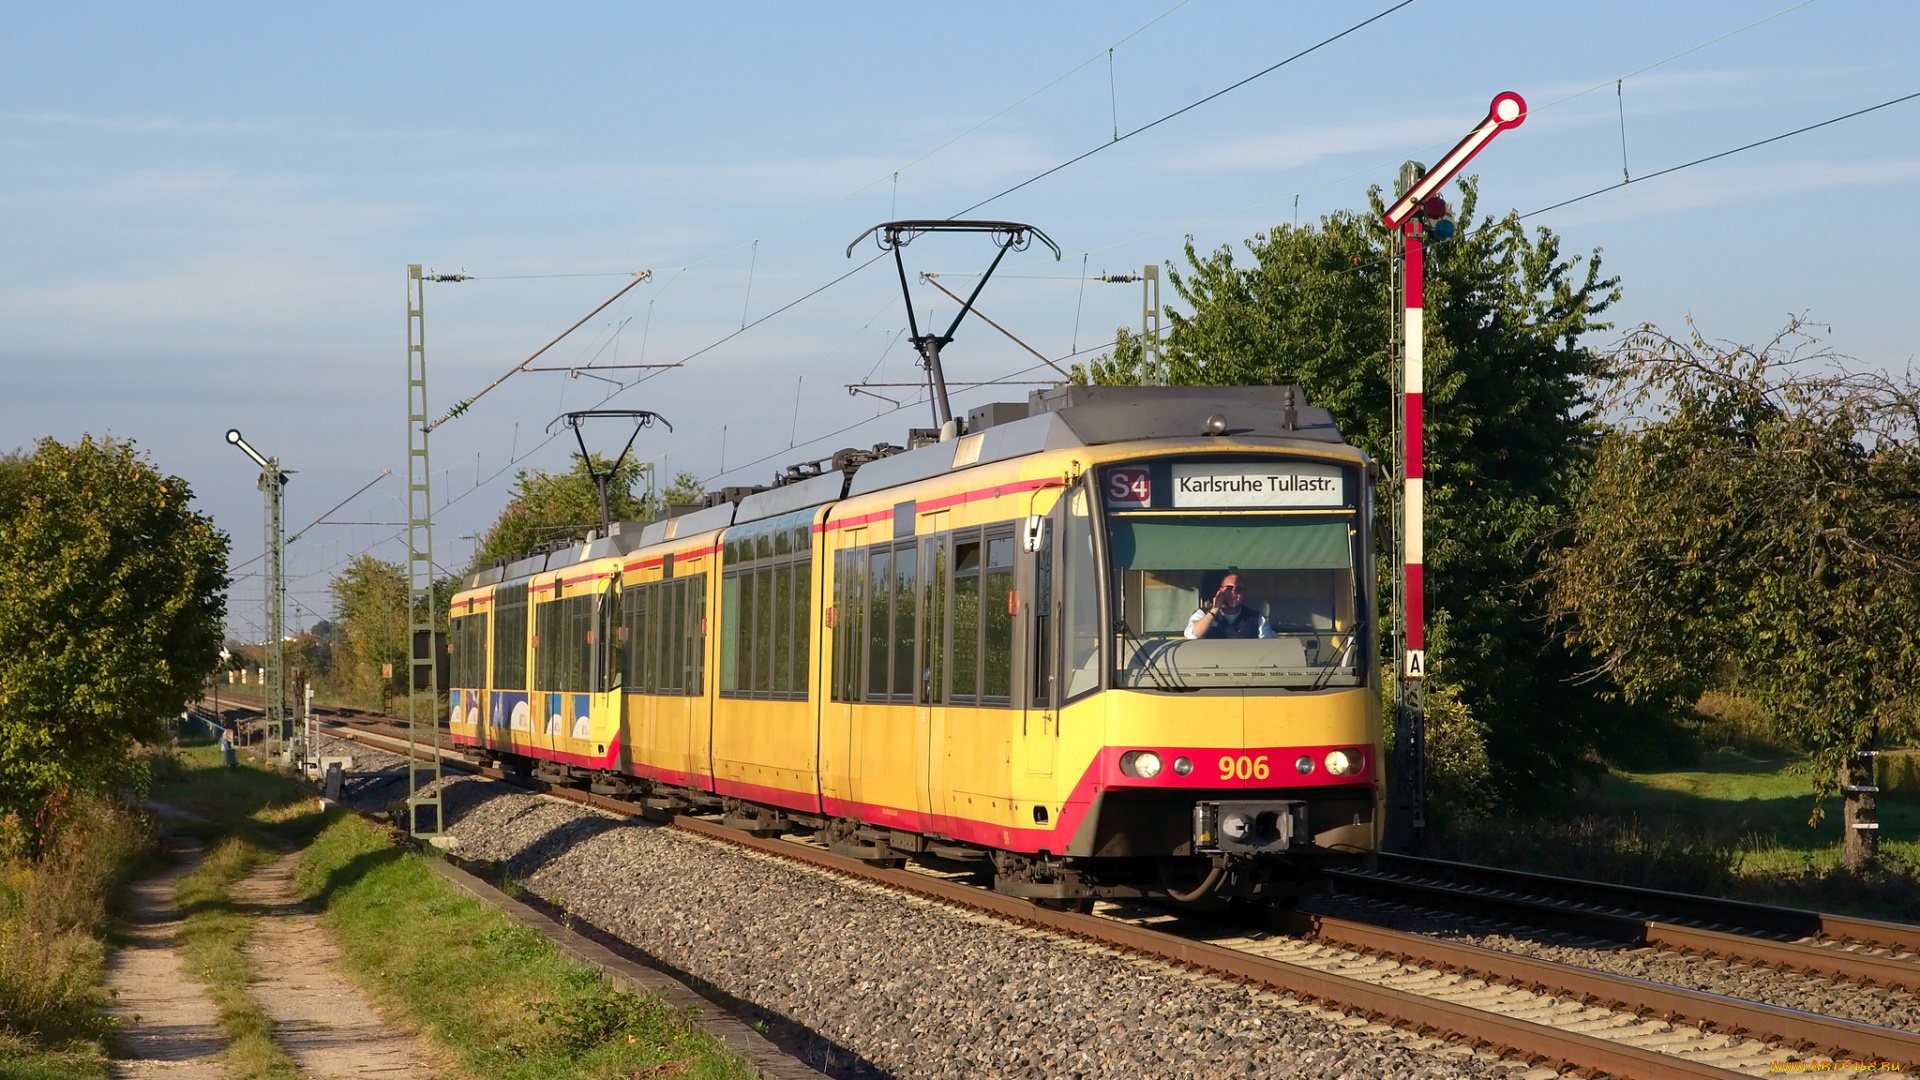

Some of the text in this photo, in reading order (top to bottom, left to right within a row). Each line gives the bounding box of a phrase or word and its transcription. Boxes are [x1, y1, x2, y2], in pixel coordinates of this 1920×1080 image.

[1110, 473, 1148, 498] S4
[1179, 475, 1335, 492] Karlsruhe Tullastr.
[1410, 653, 1421, 673] A
[1218, 755, 1270, 780] 906
